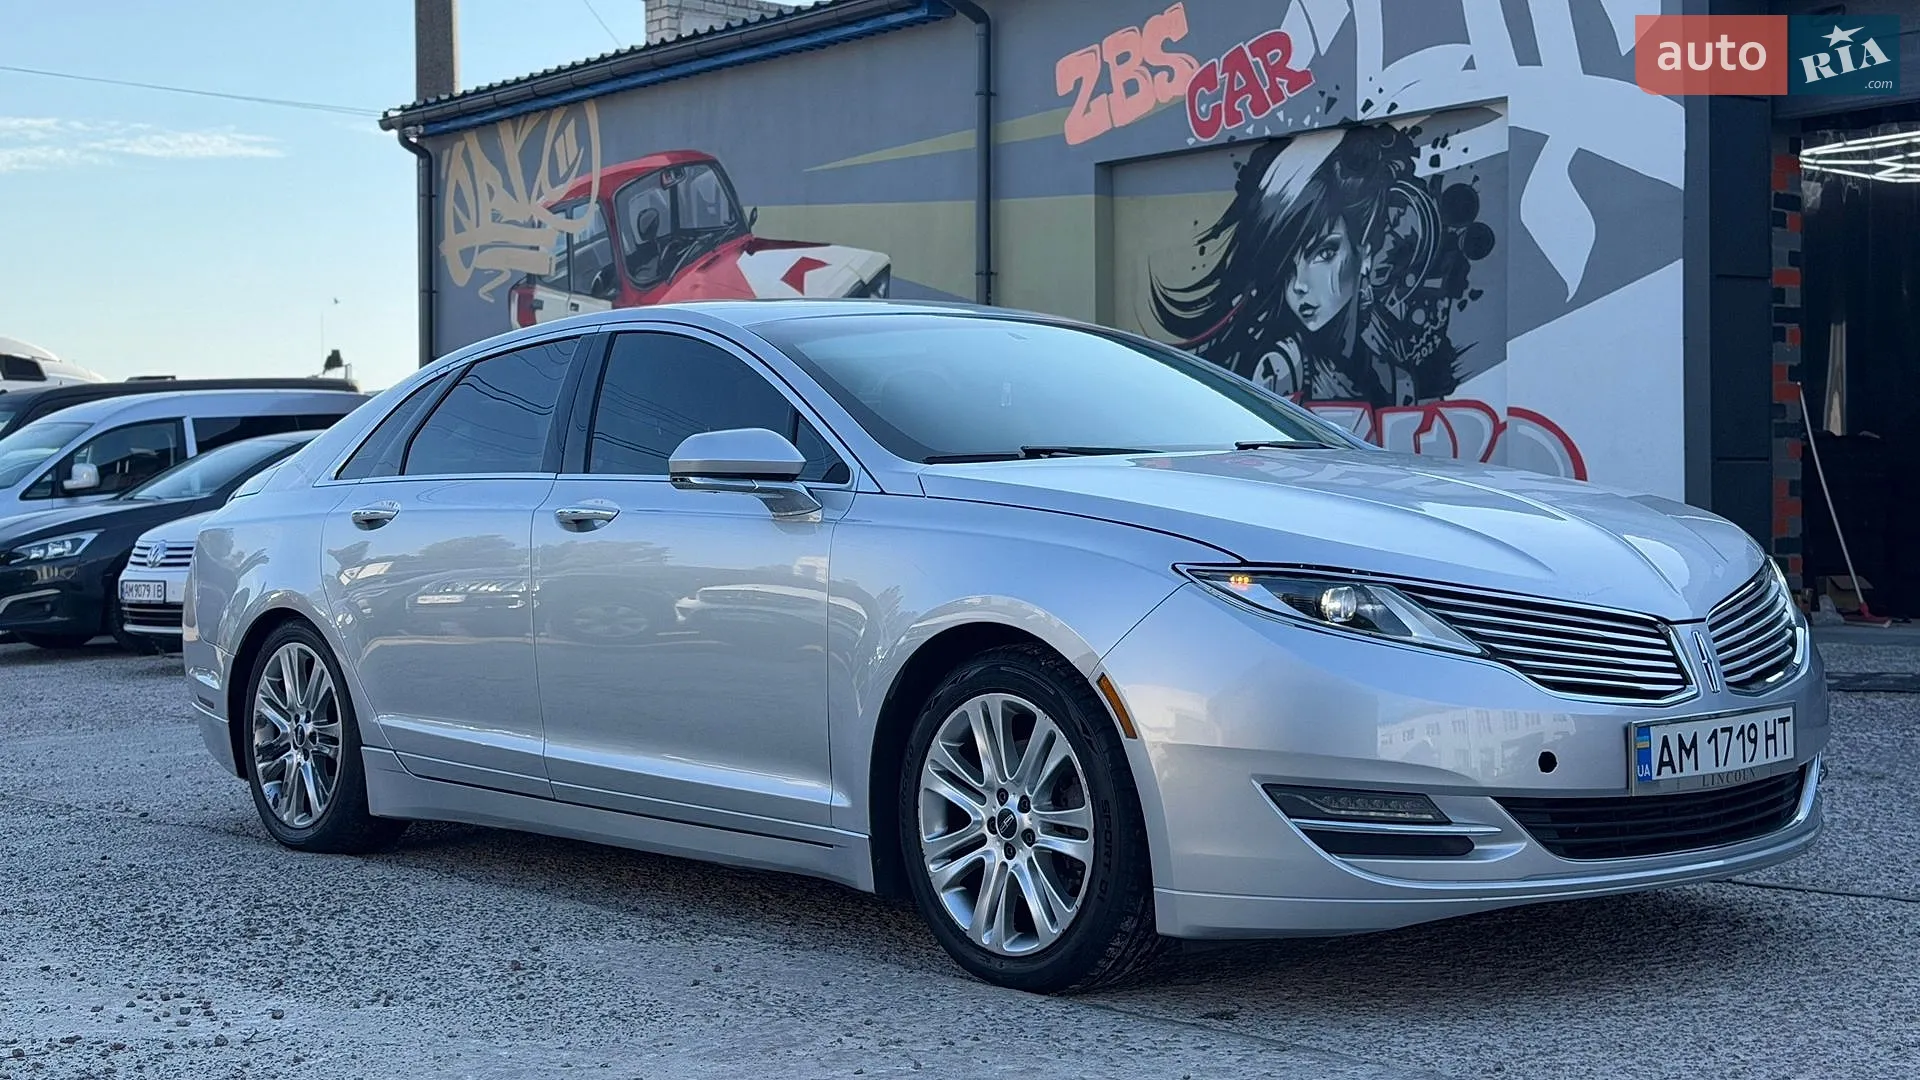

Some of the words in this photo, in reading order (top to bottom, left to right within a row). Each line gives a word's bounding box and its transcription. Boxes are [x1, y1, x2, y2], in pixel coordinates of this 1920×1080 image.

[1055, 2, 1200, 145] ZBS
[1185, 29, 1315, 142] CAR
[135, 583, 151, 599] 9079
[1656, 731, 1699, 776] AM
[1707, 722, 1758, 767] 1719
[1764, 716, 1791, 759] HT
[1637, 764, 1651, 778] UA
[1702, 768, 1757, 786] LINCOLN
